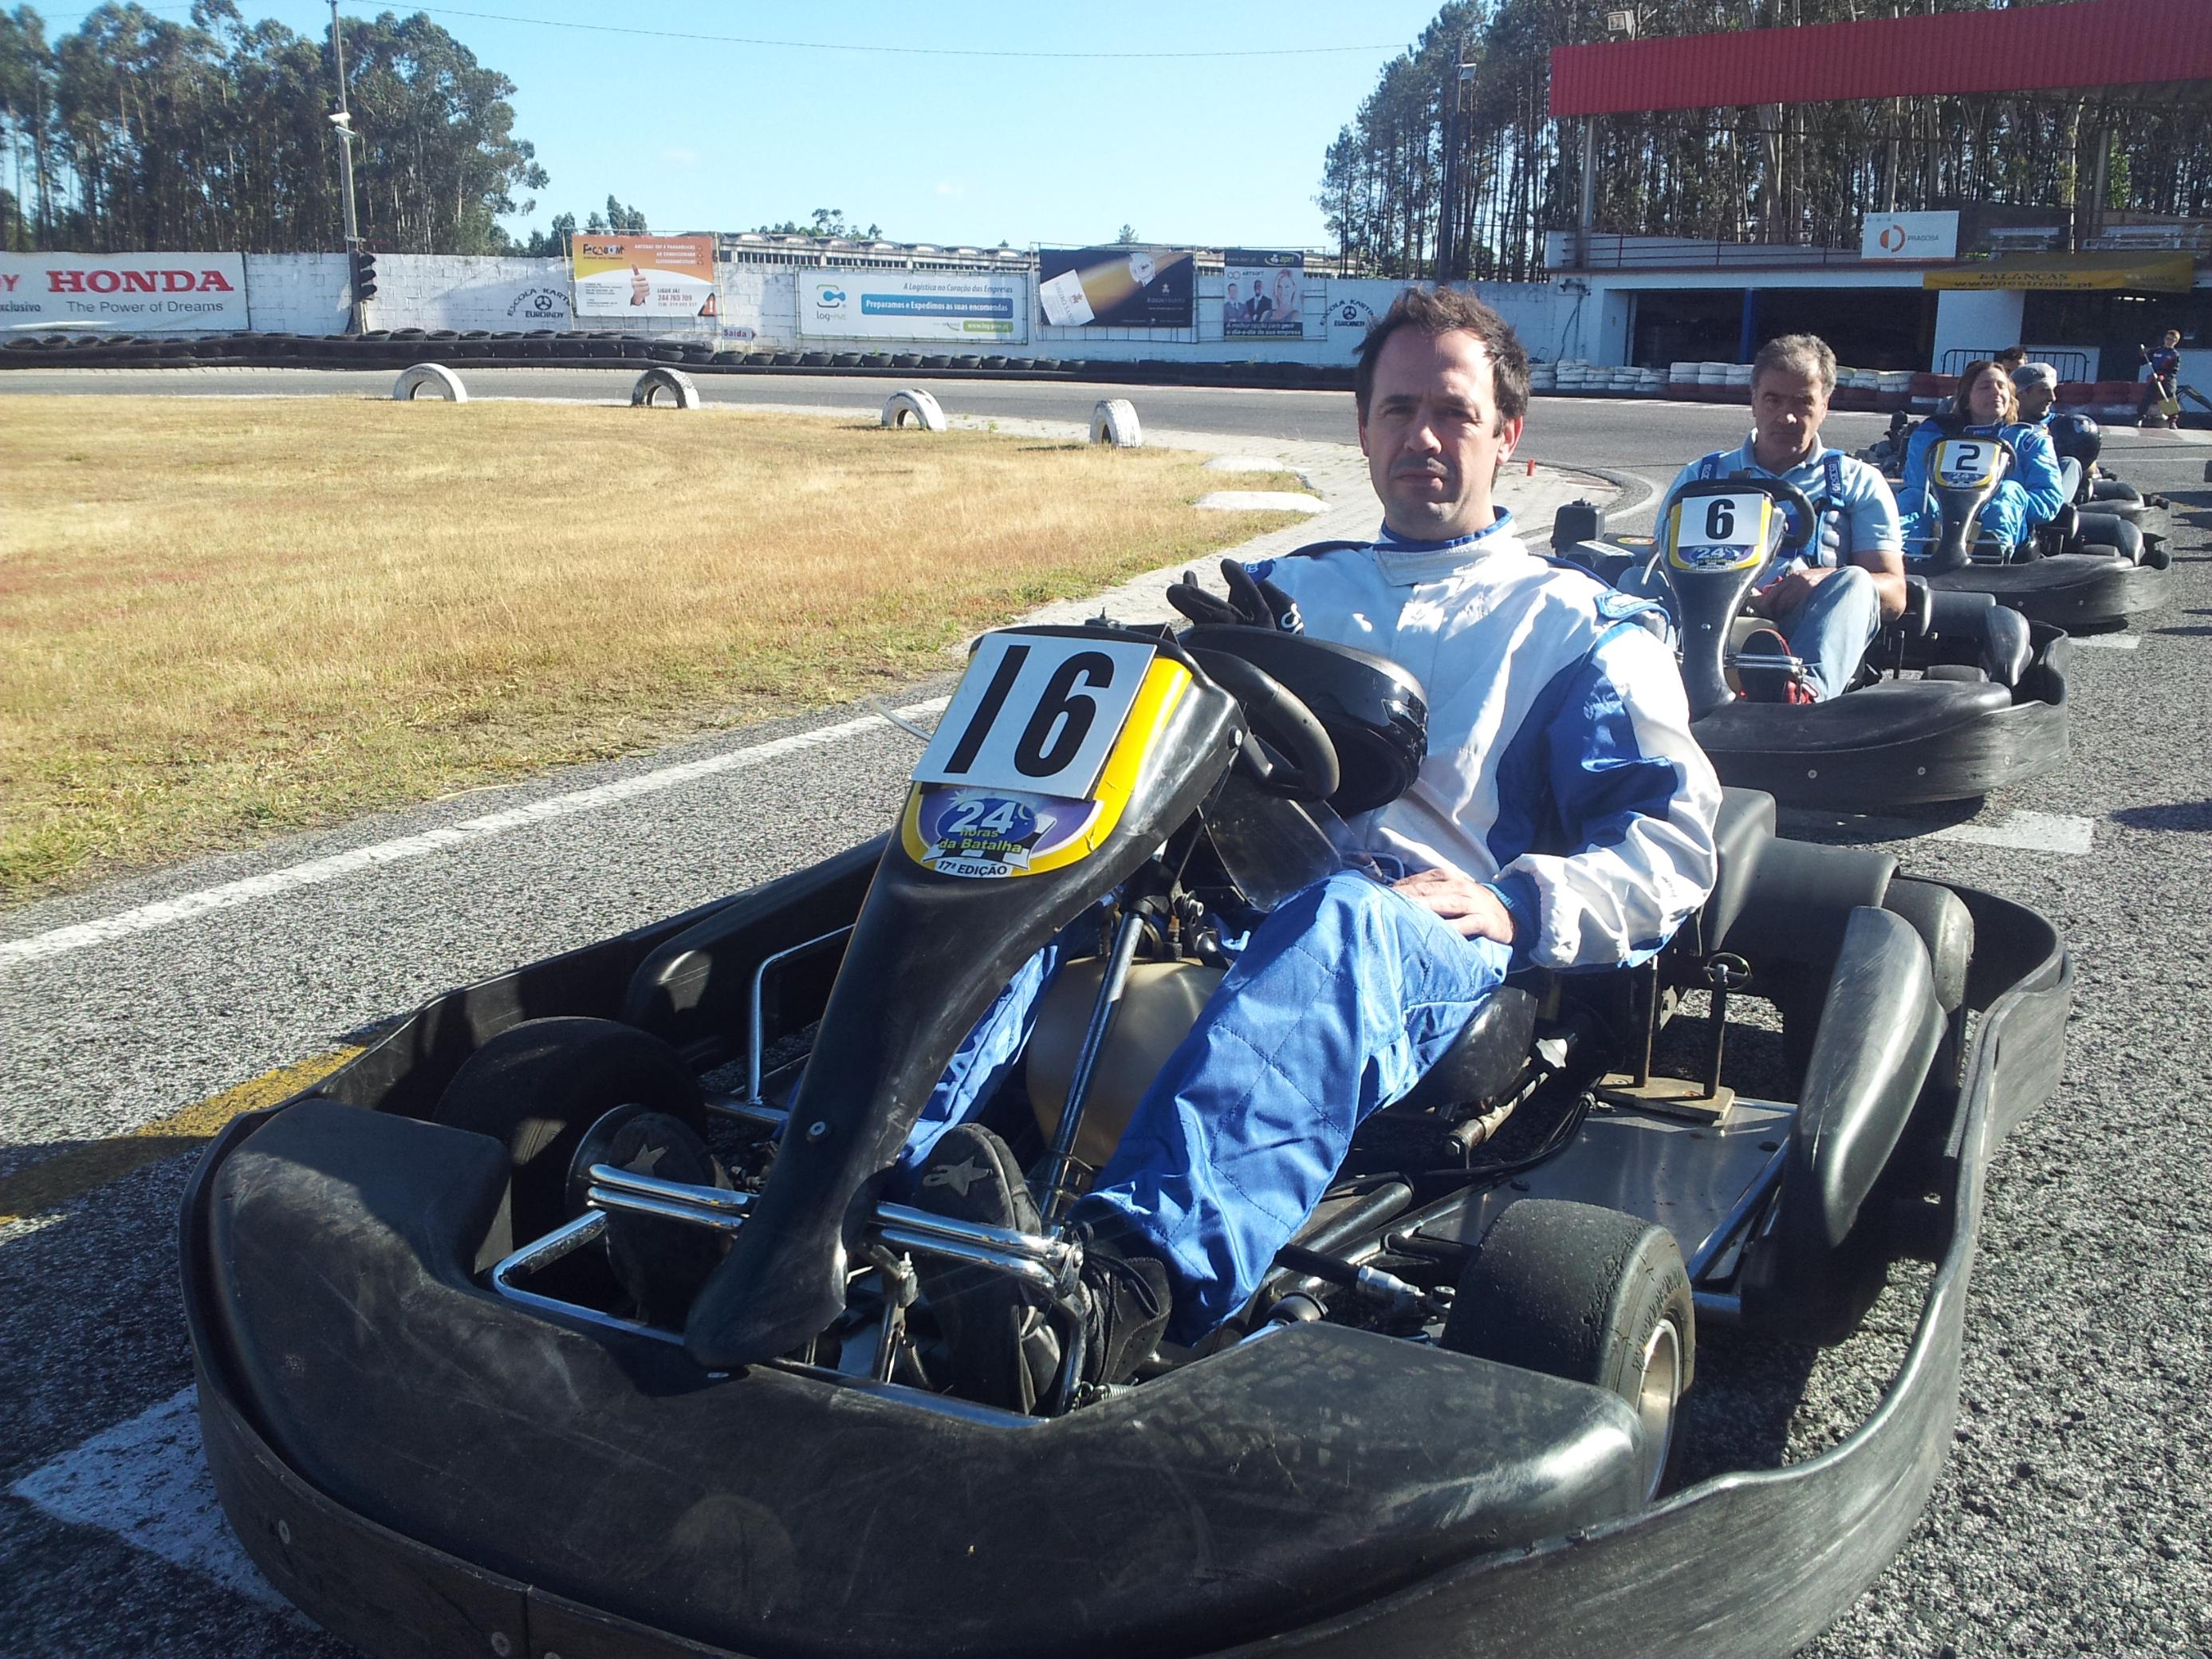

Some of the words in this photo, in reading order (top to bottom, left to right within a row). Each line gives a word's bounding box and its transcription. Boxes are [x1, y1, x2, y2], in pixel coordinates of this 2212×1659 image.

[45, 270, 234, 293] HONDA
[984, 286, 1013, 294] Empresas
[66, 301, 95, 312] The
[100, 301, 144, 313] Power
[149, 301, 163, 312] of
[167, 301, 224, 312] Dreams
[866, 300, 904, 309] Preparamos
[911, 301, 945, 311] Expedimos
[1955, 444, 1981, 471] 2
[1706, 498, 1735, 540] 6
[1697, 548, 1725, 559] 24
[943, 644, 1115, 778] 16
[947, 801, 1017, 833] 24
[960, 828, 999, 837] horas
[939, 838, 958, 850] da
[960, 838, 1022, 853] Batalha
[957, 863, 1007, 877] EDIÇÃO
